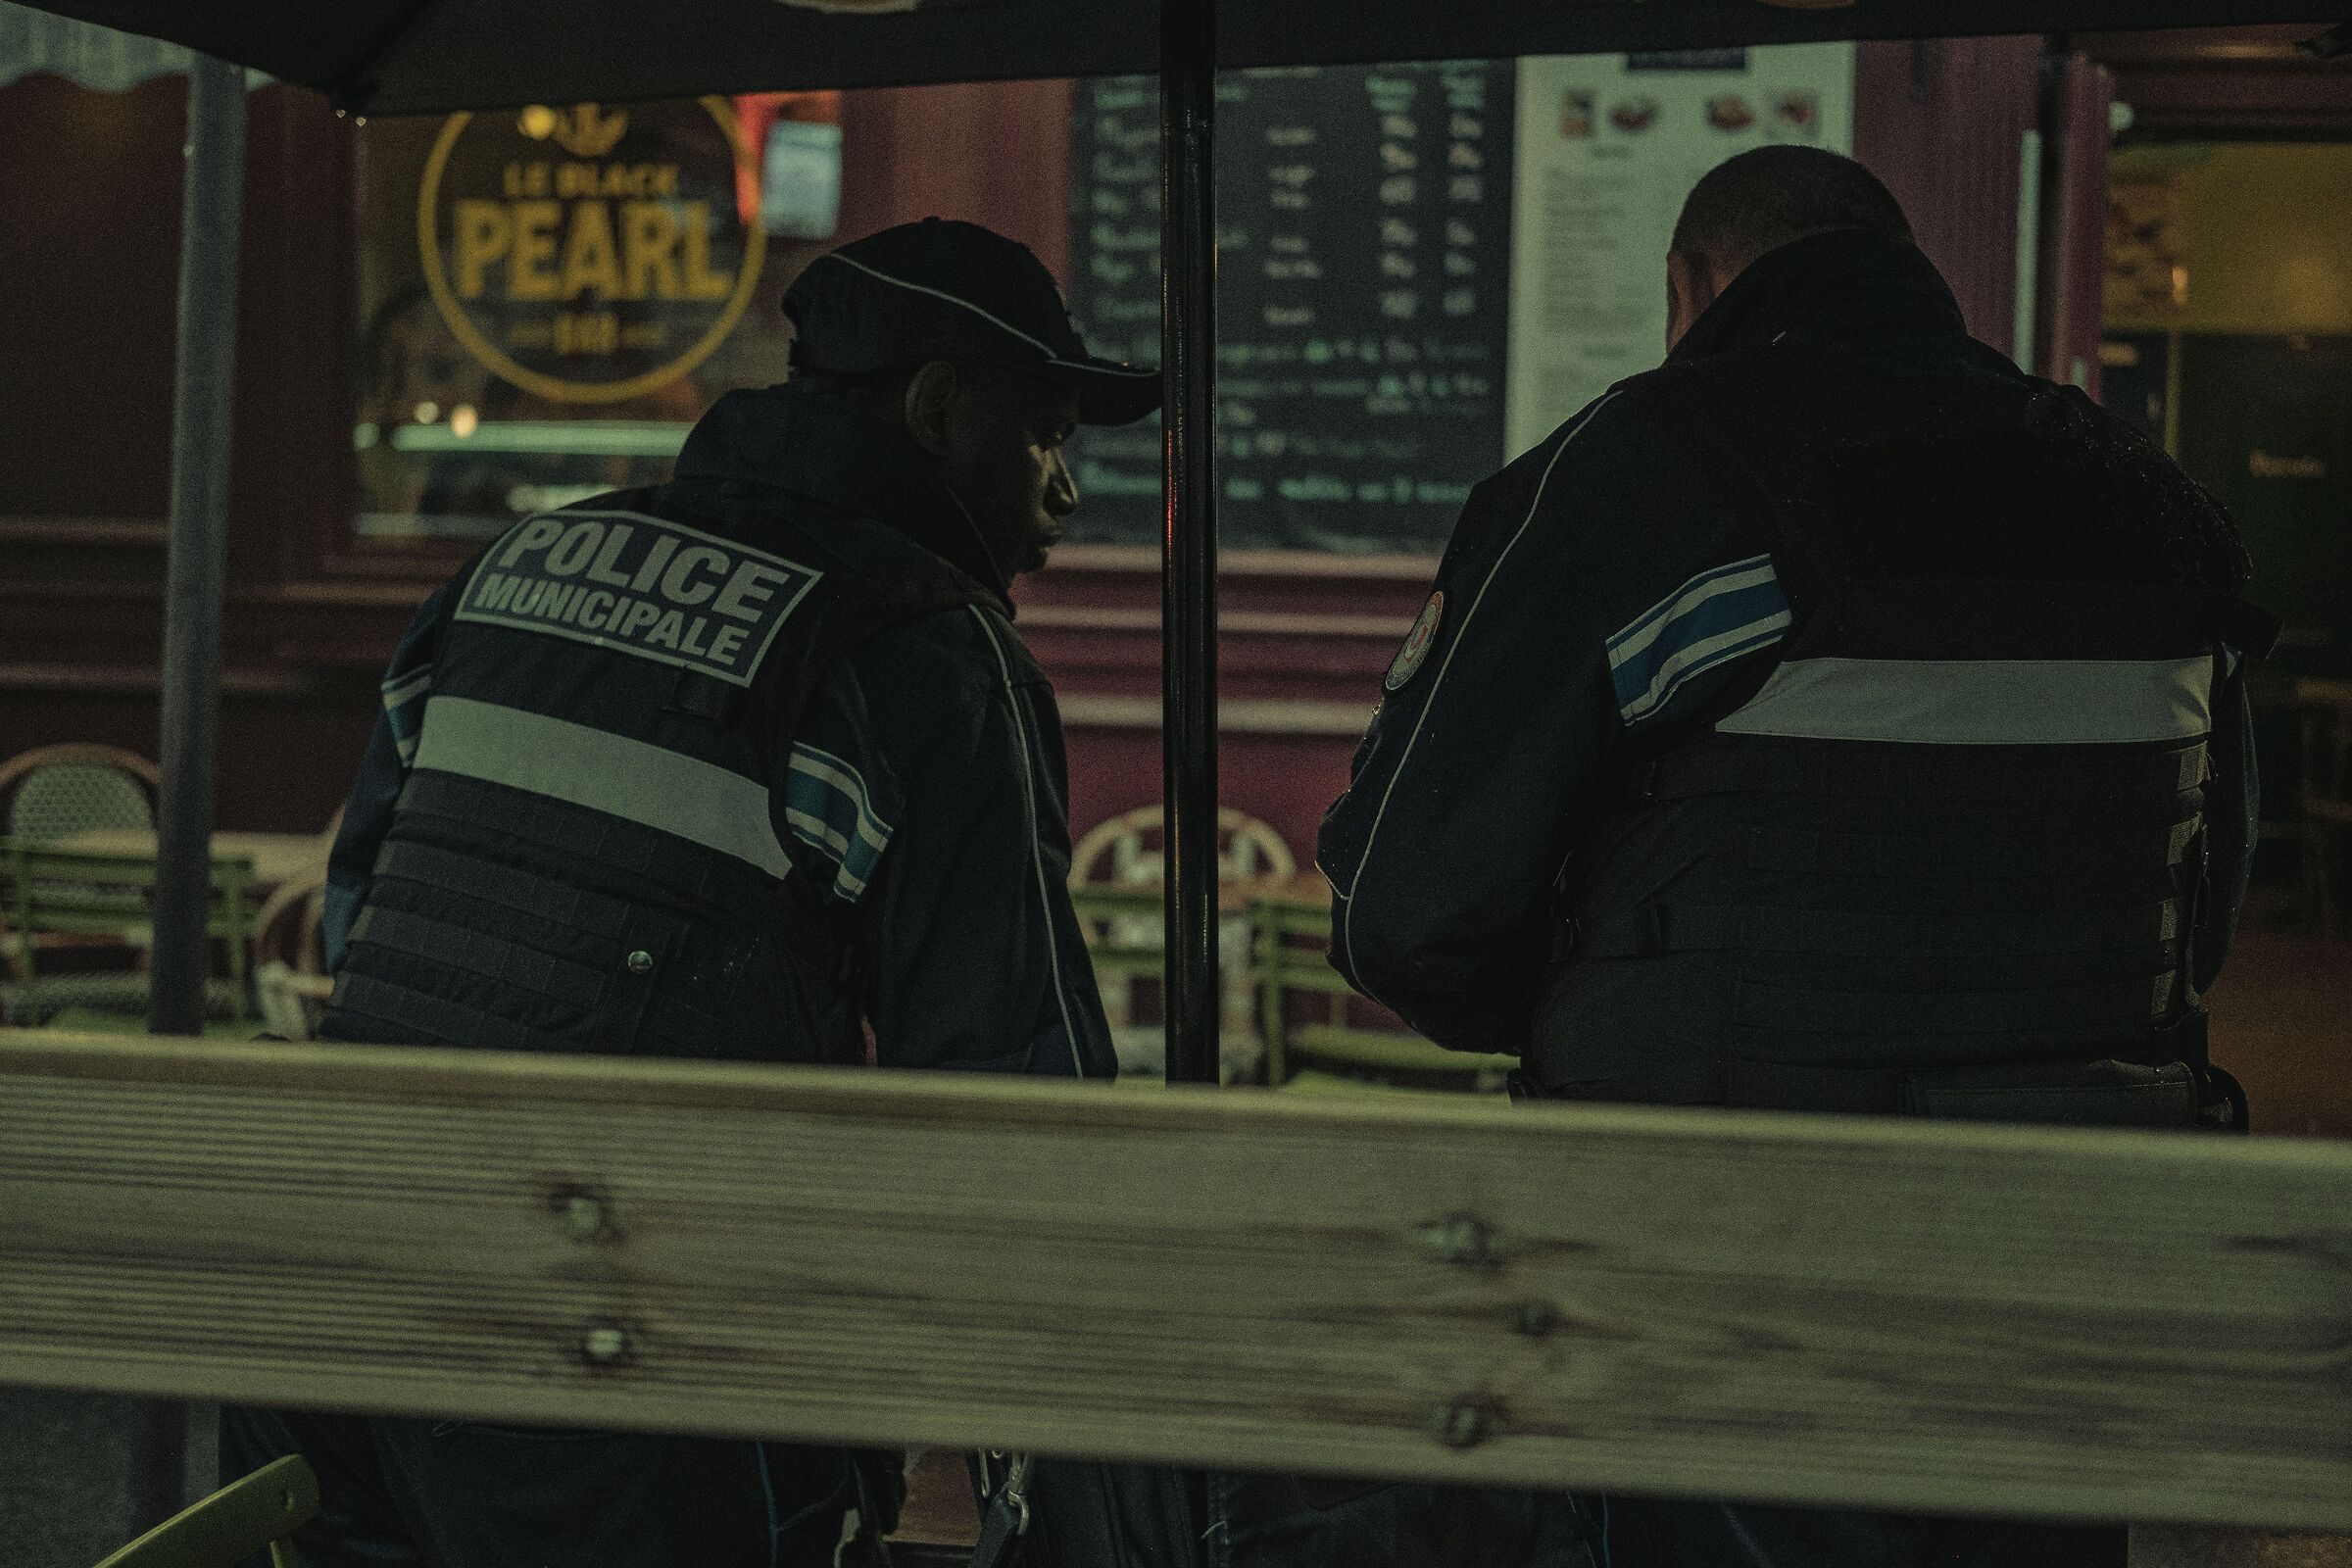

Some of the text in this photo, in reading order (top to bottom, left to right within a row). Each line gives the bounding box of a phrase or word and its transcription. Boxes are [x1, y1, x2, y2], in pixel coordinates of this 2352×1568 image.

[503, 162, 680, 197] LE BLACK
[455, 196, 735, 299] PEARL
[473, 572, 752, 666] MUNICIPALE
[497, 518, 790, 623] POLICE
